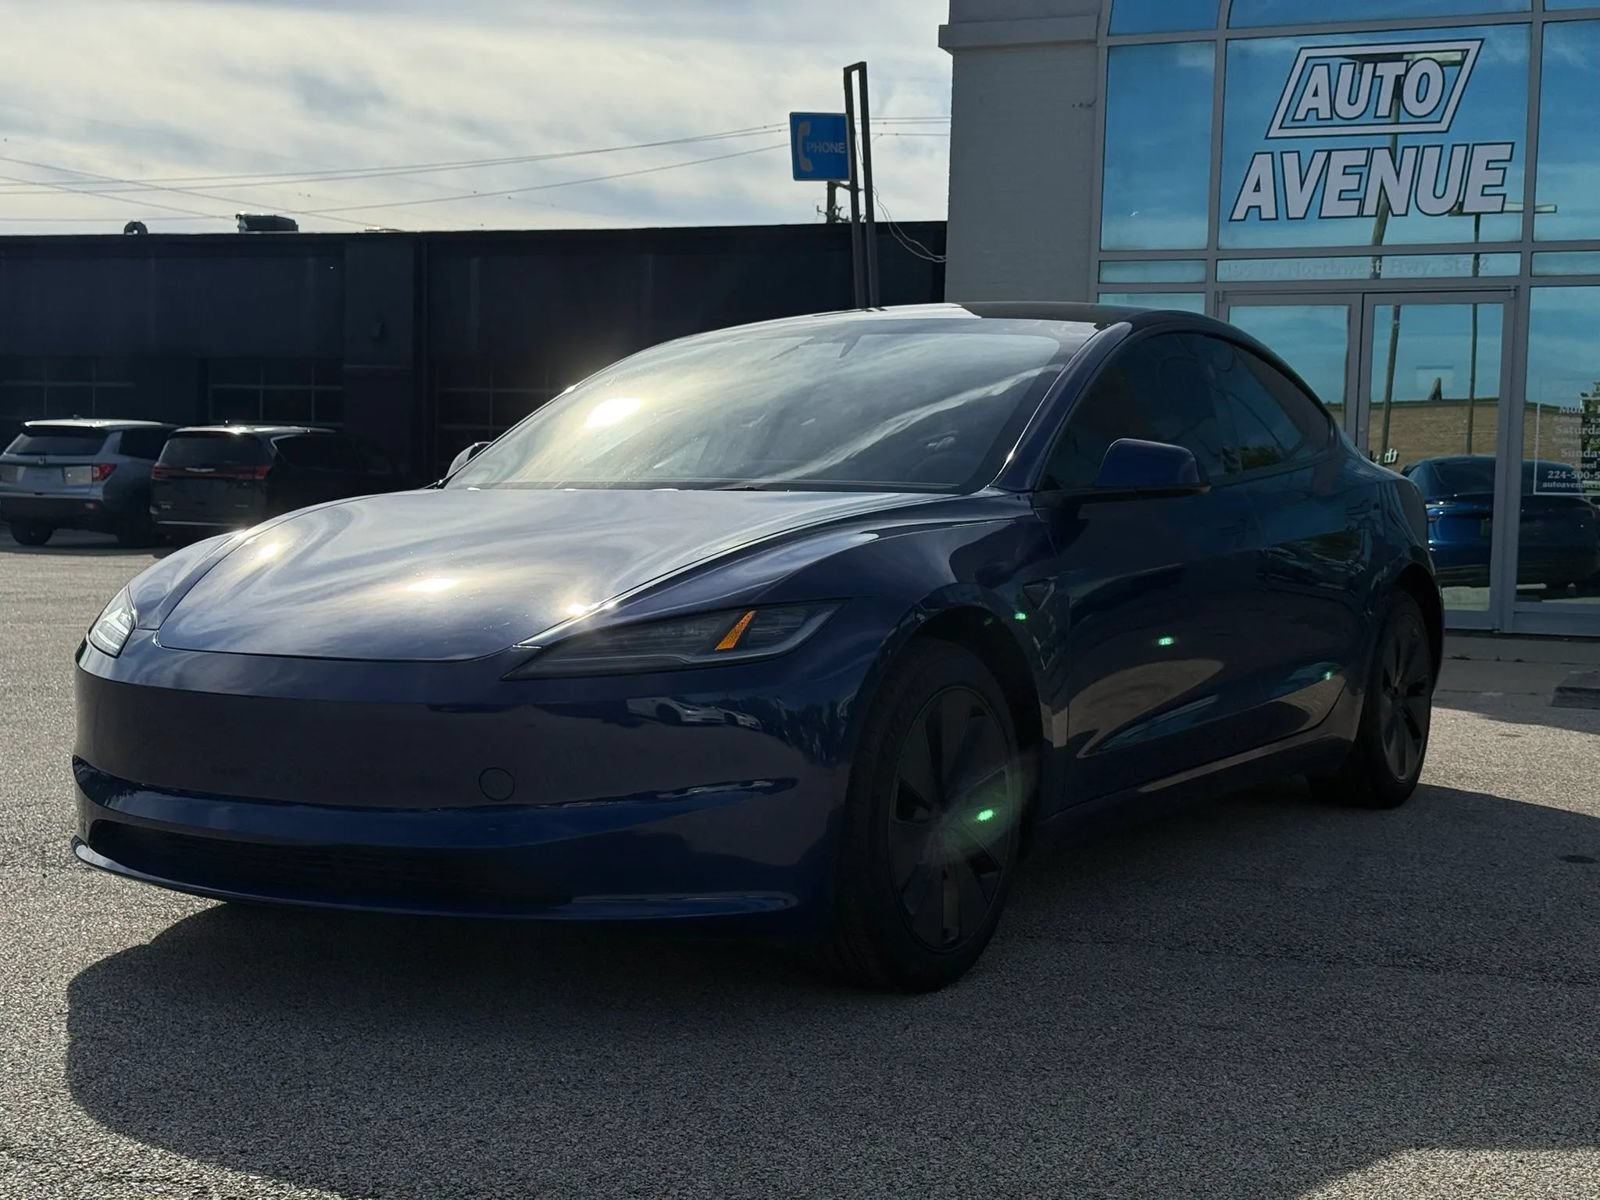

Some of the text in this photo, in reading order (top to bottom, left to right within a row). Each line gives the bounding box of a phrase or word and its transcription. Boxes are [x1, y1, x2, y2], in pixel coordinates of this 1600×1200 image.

[1291, 57, 1445, 122] AUTO
[807, 142, 846, 153] PHONE
[1229, 142, 1515, 222] AVENUE
